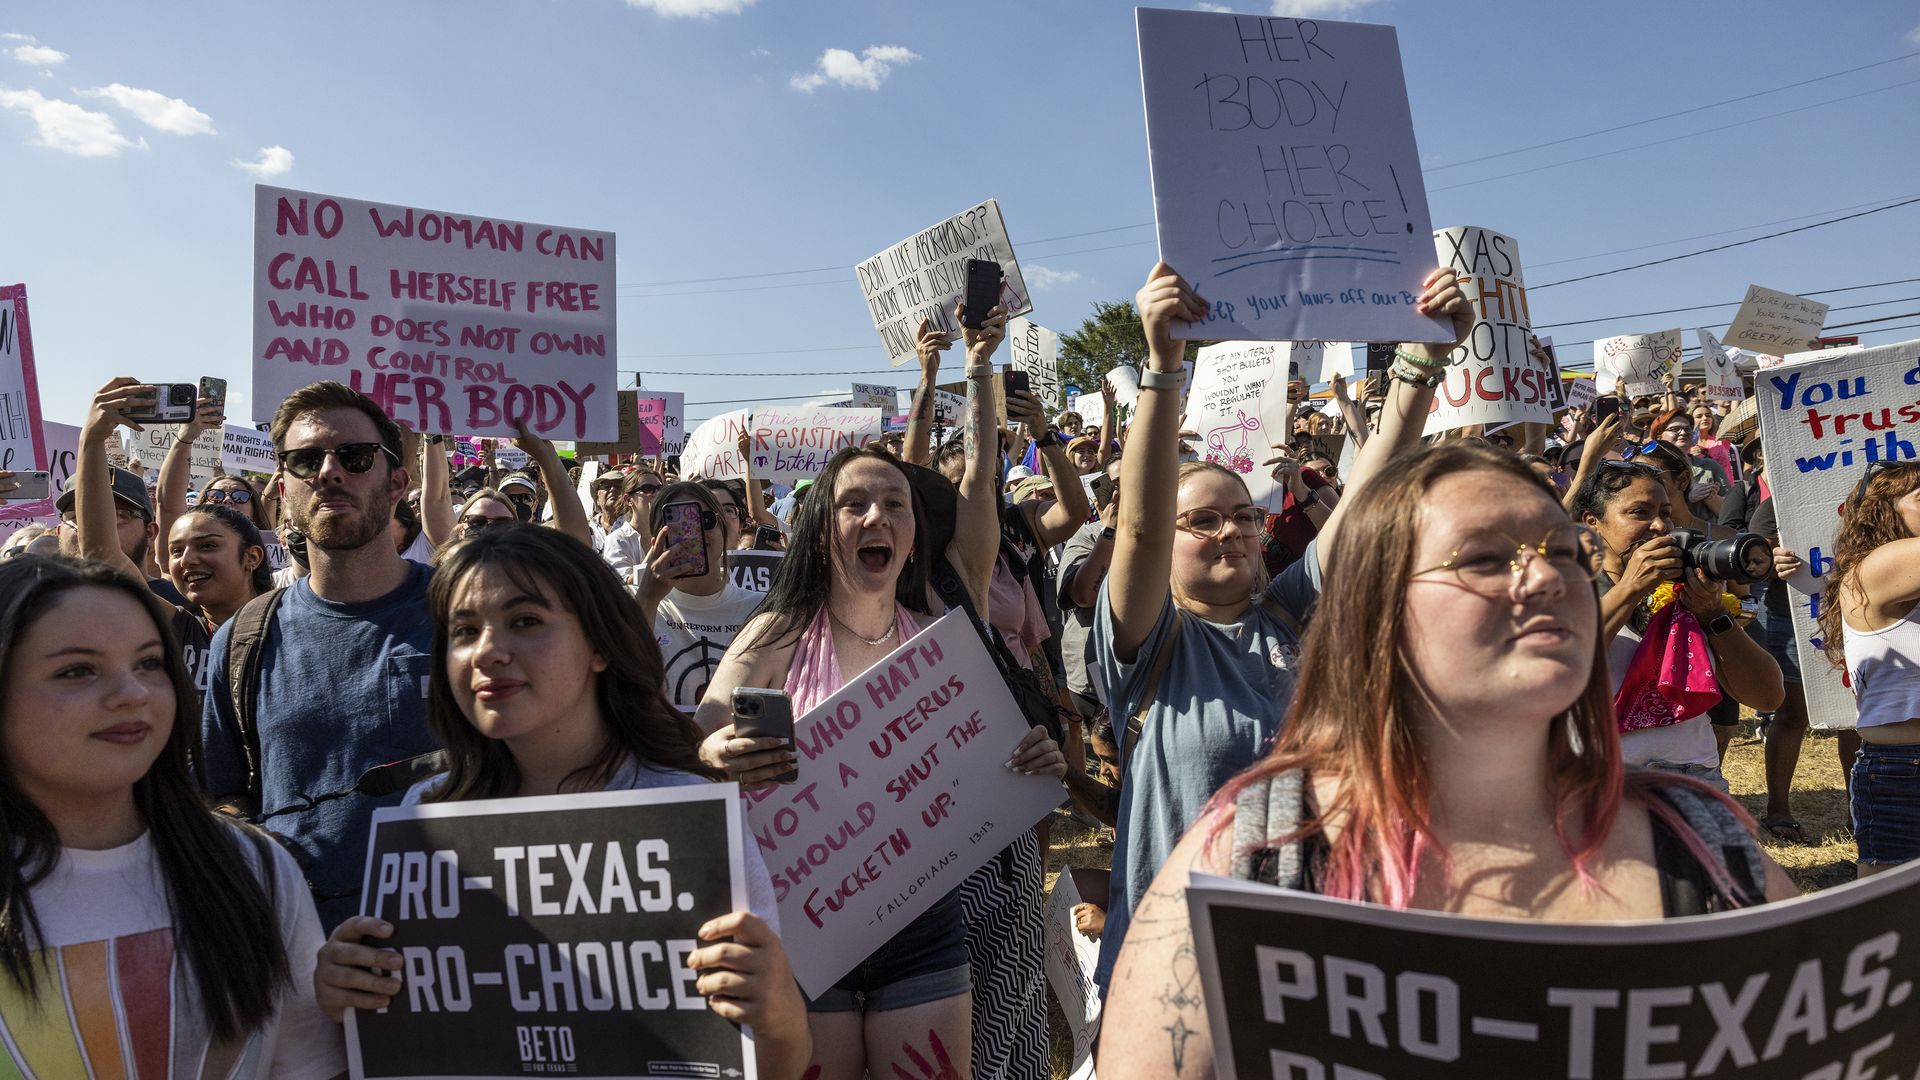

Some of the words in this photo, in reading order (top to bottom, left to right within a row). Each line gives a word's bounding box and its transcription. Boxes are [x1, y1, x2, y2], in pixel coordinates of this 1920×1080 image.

[1234, 16, 1335, 64] HER
[1194, 73, 1348, 134] BODY
[1257, 144, 1371, 197] HER
[276, 196, 344, 240] NO
[368, 207, 524, 253] WOMAN
[535, 228, 604, 262] CAN
[888, 242, 918, 280] LIKE
[1434, 227, 1514, 278] XAS
[267, 252, 370, 300] CALL
[389, 268, 517, 312] HERSELF
[526, 280, 600, 312] FREE
[868, 286, 903, 325] IGNORE
[924, 262, 955, 299] JUST
[1246, 294, 1290, 320] your
[1298, 290, 1335, 308] laws
[1339, 288, 1366, 306] off
[1371, 292, 1399, 306] our
[1456, 276, 1531, 330] HT!
[267, 300, 356, 330] WHO
[370, 314, 451, 347] DOES
[459, 324, 521, 354] NOT
[529, 331, 606, 357] OWN
[880, 316, 918, 360] IGNORE
[1738, 329, 1781, 343] CREEPY
[1781, 337, 1804, 347] AF
[264, 336, 350, 366] AND
[366, 346, 518, 384] CONTROL
[1212, 353, 1227, 366] IF
[1243, 345, 1276, 359] UTERUS
[1216, 362, 1238, 377] SHOT
[1239, 356, 1272, 371] BULLETS
[855, 384, 871, 394] OUR
[1039, 358, 1058, 402] SAFE
[1203, 402, 1217, 411] TO
[1219, 389, 1262, 407] REGULATE
[1222, 374, 1240, 386] YOU
[1243, 378, 1267, 392] WANT
[1708, 384, 1743, 398] DISSENT
[1769, 372, 1872, 411] You
[350, 369, 453, 433] HER
[463, 379, 596, 439] BODY
[640, 415, 658, 425] ERUS
[756, 408, 805, 425] this
[812, 411, 834, 425] is
[837, 413, 880, 434] my
[222, 443, 242, 455] MAN
[244, 447, 276, 460] RIGHTS
[224, 432, 235, 441] RO
[236, 435, 261, 446] RIGHTS
[1794, 431, 1918, 474] with
[704, 450, 746, 479] CARE
[684, 622, 722, 633] REFORM
[724, 624, 741, 633] NO
[796, 700, 862, 762] WHO
[865, 638, 945, 710] HATH
[838, 761, 860, 789] A
[868, 674, 966, 760] UTERUS
[771, 800, 876, 903] SHOULD
[885, 742, 940, 803] SHUT
[945, 709, 987, 750] THE
[968, 820, 995, 846] 13:13
[374, 838, 695, 920] PRO-TEXAS.
[376, 938, 709, 1015] RO-CHOICE
[1255, 931, 1914, 1080] PRO-TEXAS.
[516, 1026, 577, 1062] BETO
[533, 1063, 546, 1072] FOR
[547, 1063, 567, 1073] TEXAS
